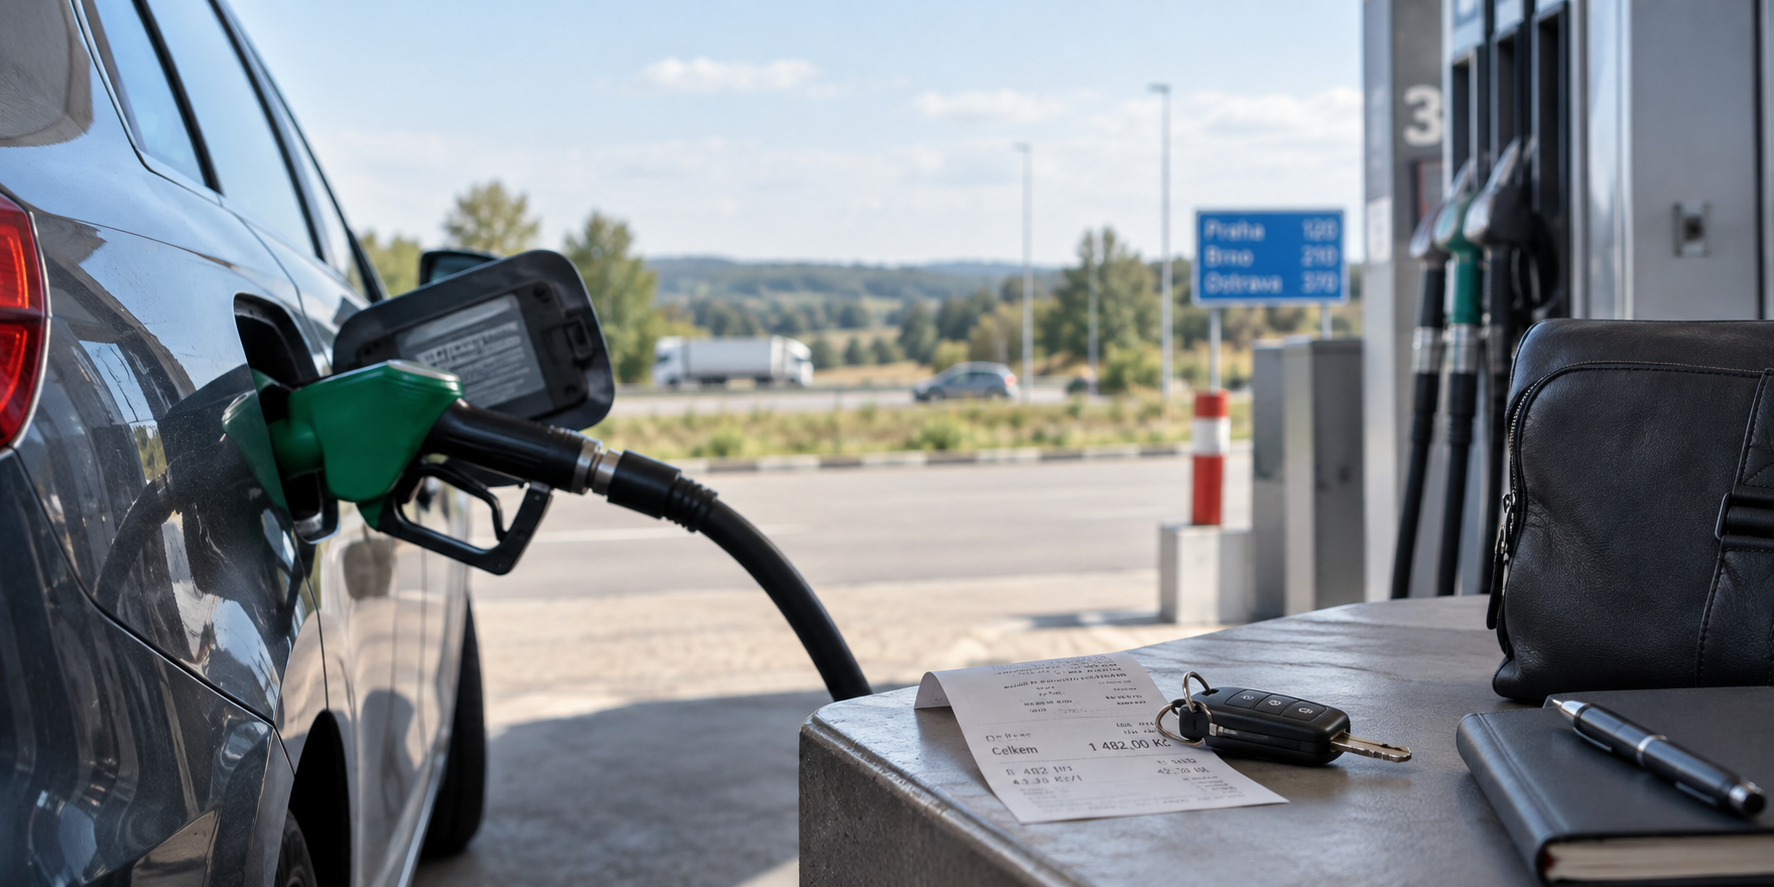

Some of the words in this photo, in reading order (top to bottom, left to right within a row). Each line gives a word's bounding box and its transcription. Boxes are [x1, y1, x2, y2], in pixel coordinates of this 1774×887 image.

[1404, 84, 1442, 146] 3
[1204, 219, 1265, 241] Praha
[1204, 245, 1254, 268] Brno
[1302, 245, 1338, 268] 210
[1204, 271, 1283, 294] Ostrava
[992, 745, 1039, 756] Celkem
[1088, 742, 1097, 752] 1
[1102, 739, 1150, 752] 482,00
